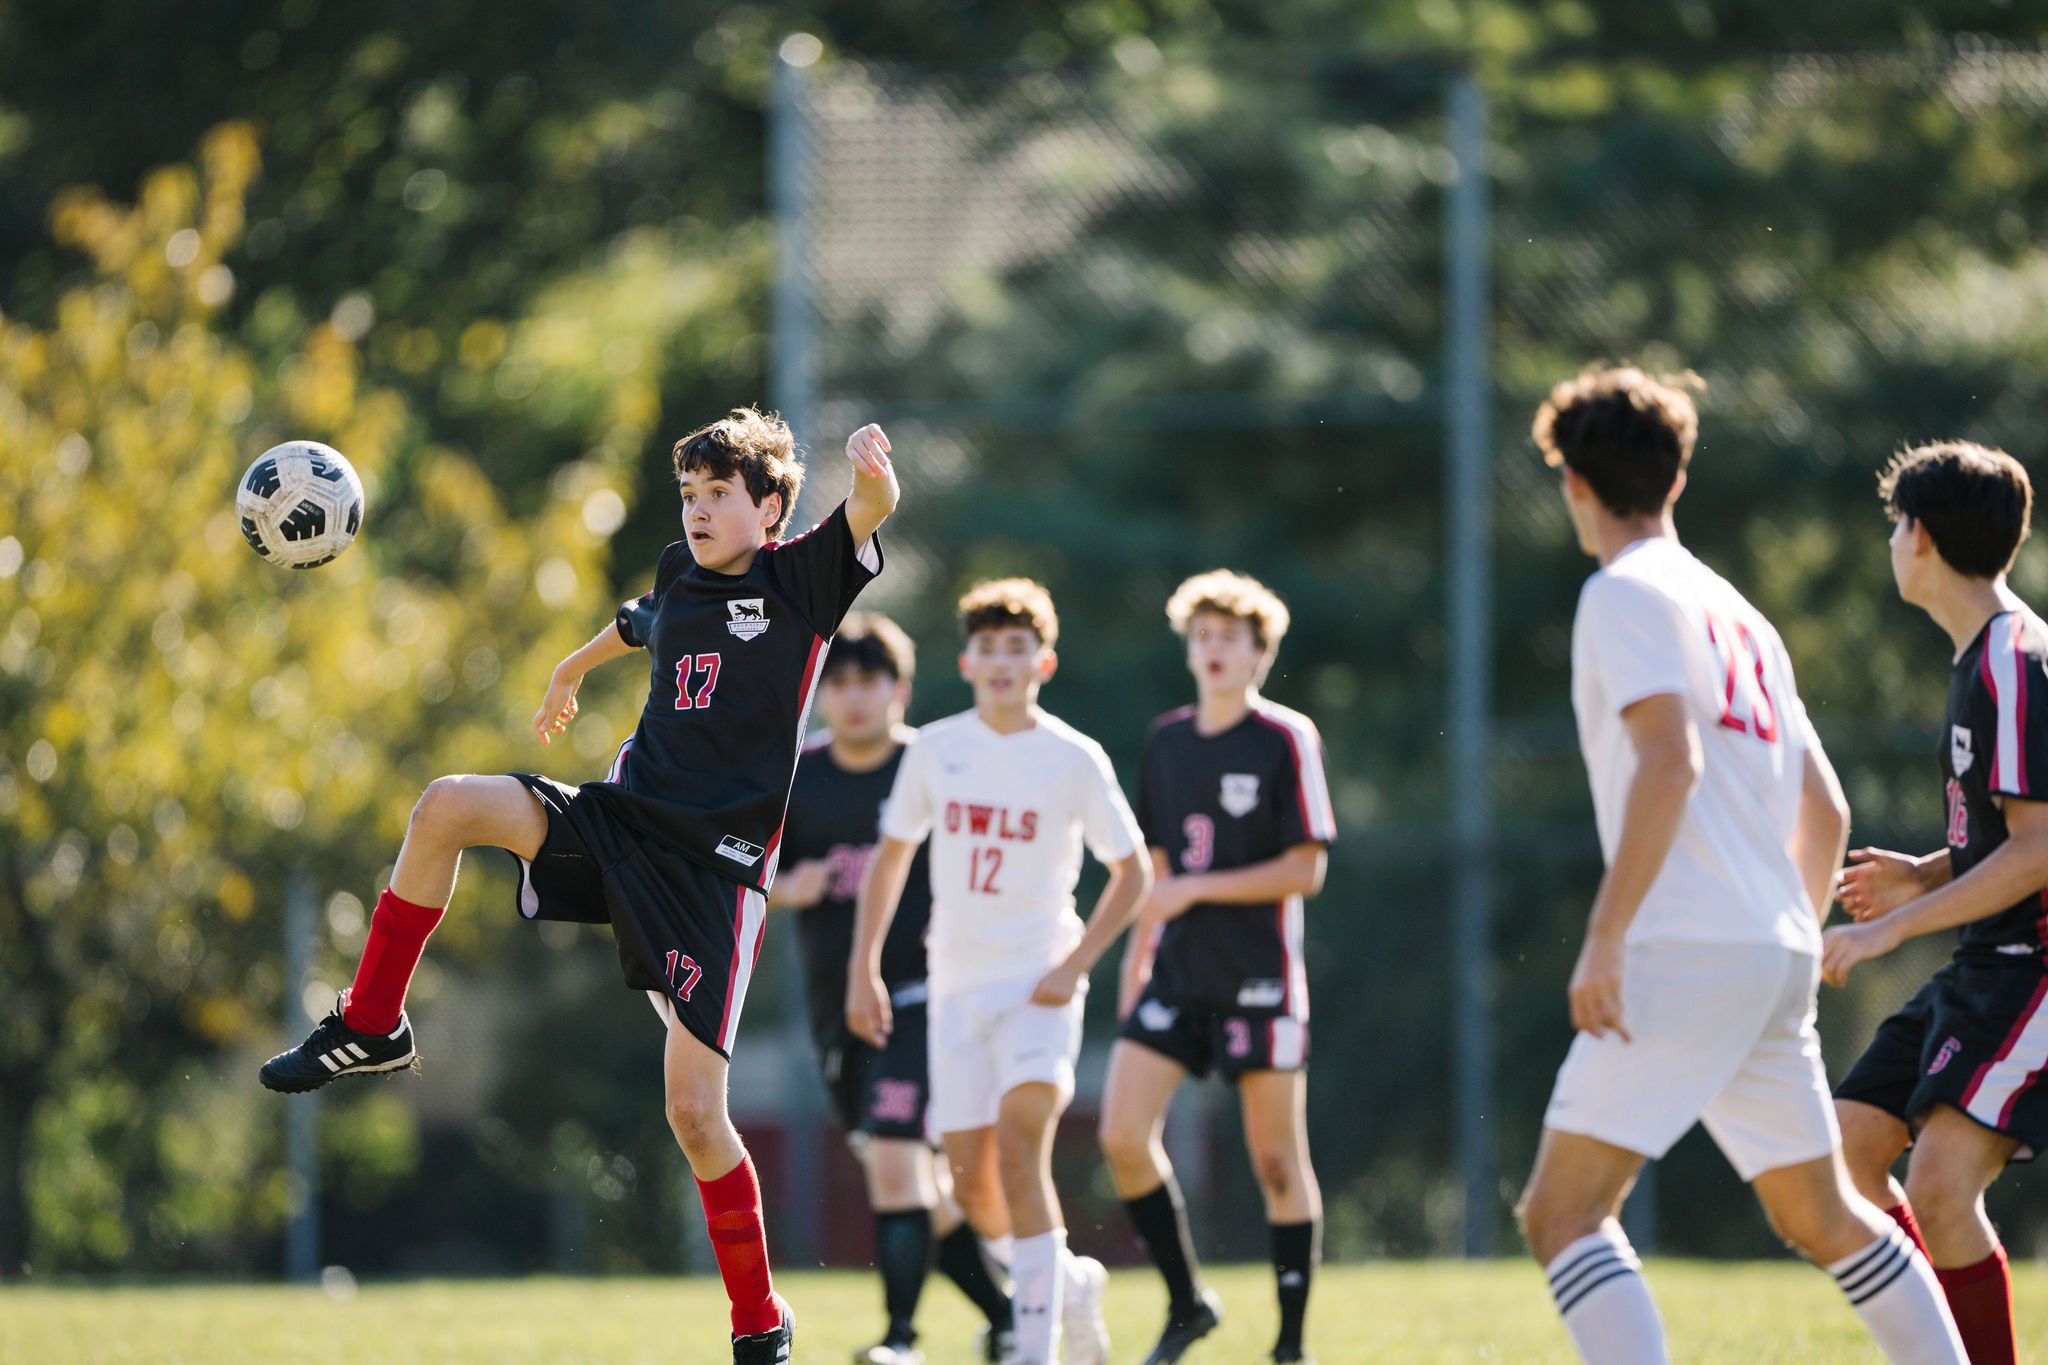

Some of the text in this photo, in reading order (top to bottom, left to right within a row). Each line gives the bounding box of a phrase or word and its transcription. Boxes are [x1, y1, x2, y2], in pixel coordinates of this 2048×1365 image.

[675, 652, 721, 710] 17
[1704, 609, 1777, 742] 23
[945, 800, 1038, 841] OWLS
[1946, 776, 1968, 849] 16
[733, 841, 750, 853] AM
[1181, 813, 1214, 872] 3
[969, 847, 1004, 893] 12
[666, 949, 702, 1002] 17
[1223, 1016, 1252, 1057] 3
